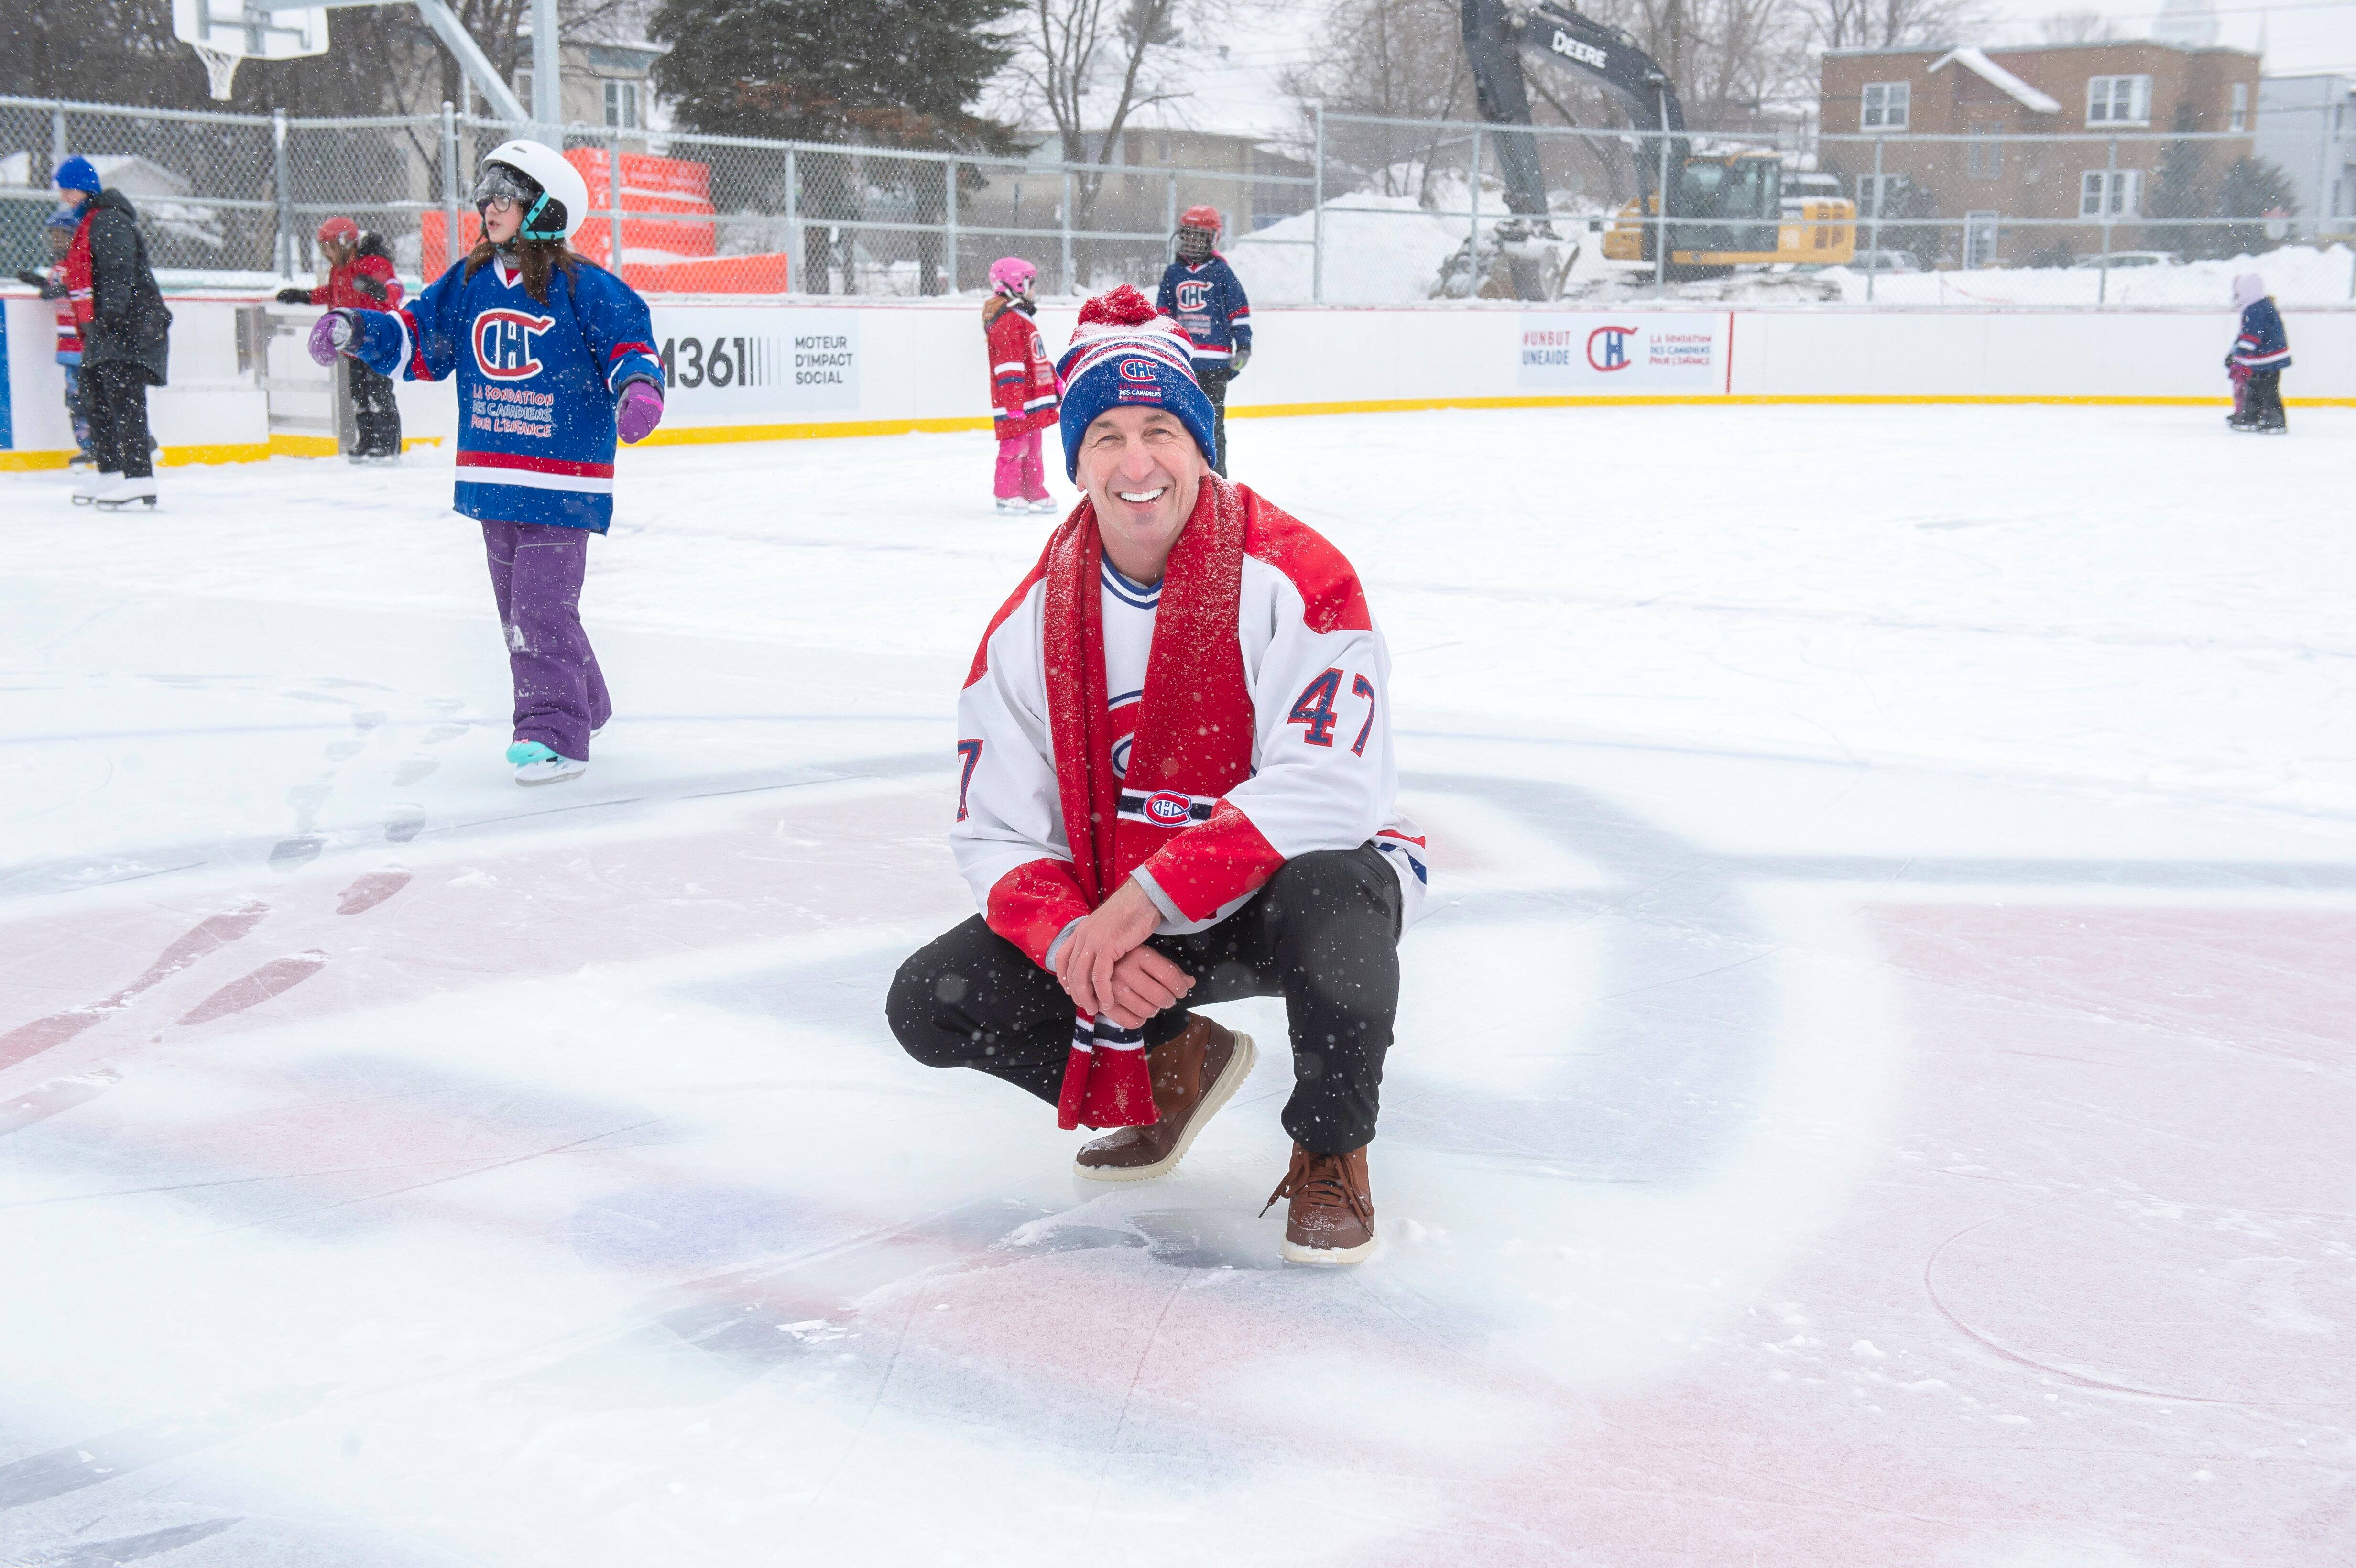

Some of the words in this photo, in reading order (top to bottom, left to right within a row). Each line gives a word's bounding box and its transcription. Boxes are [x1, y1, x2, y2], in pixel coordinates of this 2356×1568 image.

[1552, 30, 1608, 69] DEERE
[795, 337, 847, 349] MOTEUR
[796, 353, 852, 367] D'IMPACT
[796, 371, 843, 384] SOCIAL
[473, 383, 483, 400] LA
[485, 384, 554, 406] FONDATION
[487, 403, 552, 422] CANADIENS
[1287, 667, 1375, 757] 47
